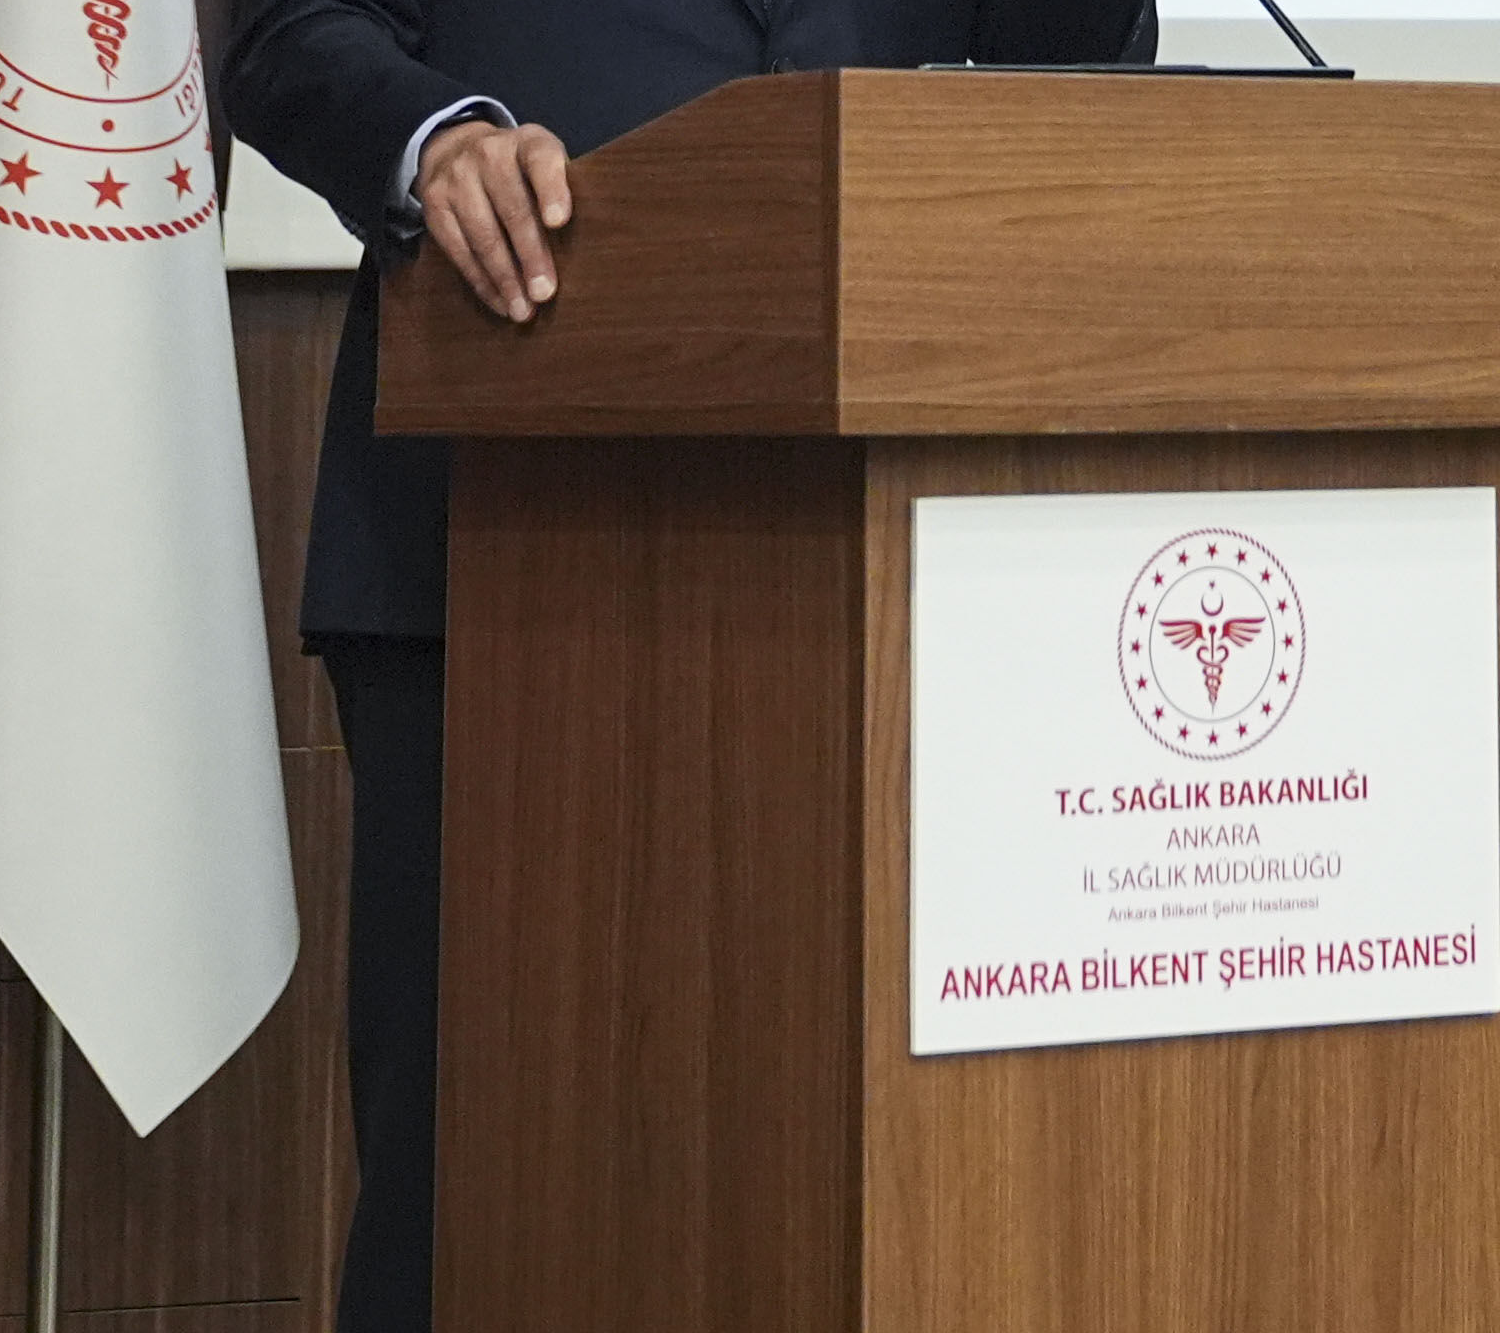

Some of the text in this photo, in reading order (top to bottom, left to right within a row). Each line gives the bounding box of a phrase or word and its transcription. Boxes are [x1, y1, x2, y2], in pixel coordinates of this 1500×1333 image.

[1055, 768, 1370, 816] T.C. SAĞLIK BAKANLIĞI
[1166, 823, 1261, 851] ANKARA
[1083, 849, 1343, 894] İL SAĞLIK MÜDÜRLÜĞÜ
[1107, 895, 1320, 922] Ankara Bilkent Şehir Hastanesi
[939, 923, 1478, 1002] ANKARA BİLKENT ŞEHİR HASTANESİ
